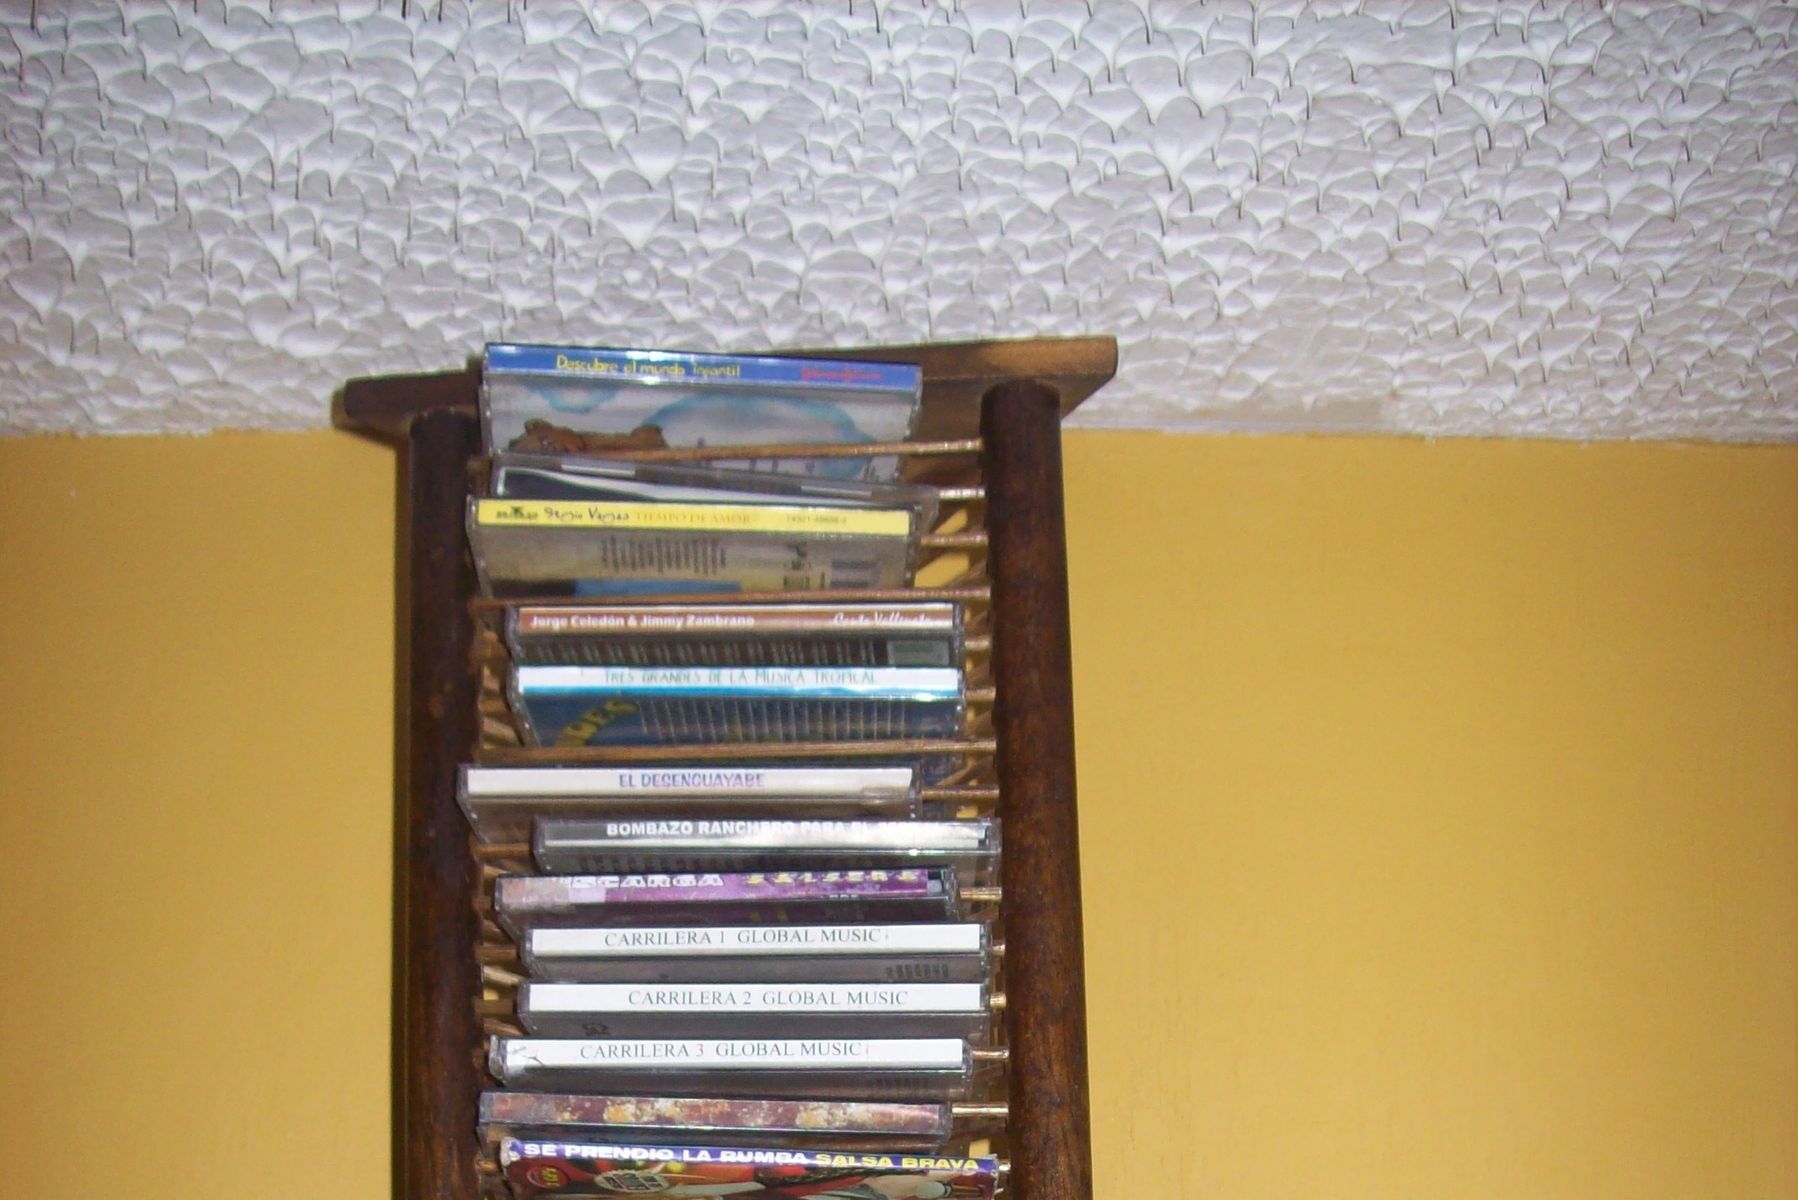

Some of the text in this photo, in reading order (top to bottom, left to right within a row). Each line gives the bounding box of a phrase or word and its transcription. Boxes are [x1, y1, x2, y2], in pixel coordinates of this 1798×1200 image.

[556, 354, 618, 373] Descubre
[623, 358, 637, 375] el
[640, 362, 686, 377] mundo
[530, 614, 569, 631] Jorge
[626, 614, 638, 628] &
[640, 614, 684, 631] Jimmy
[685, 613, 755, 628] Zambrano
[642, 671, 700, 684] GRANDES
[707, 671, 721, 684] DE
[729, 671, 748, 684] LA
[814, 670, 876, 684] TROPICAL
[618, 773, 635, 788] EL
[606, 820, 693, 837] BOMBAZO
[697, 820, 794, 835] RANCHERO
[604, 927, 882, 948] CARRILERA 1 GLOBAL MUSIC
[628, 990, 908, 1006] CARRILERA 2 GLOBAL MUSIC
[579, 1041, 862, 1059] CARRILERA 3 GLOBAL MUSIC
[524, 1143, 980, 1170] SE PRENDIO LA RUMBA SALSA BRAVA
